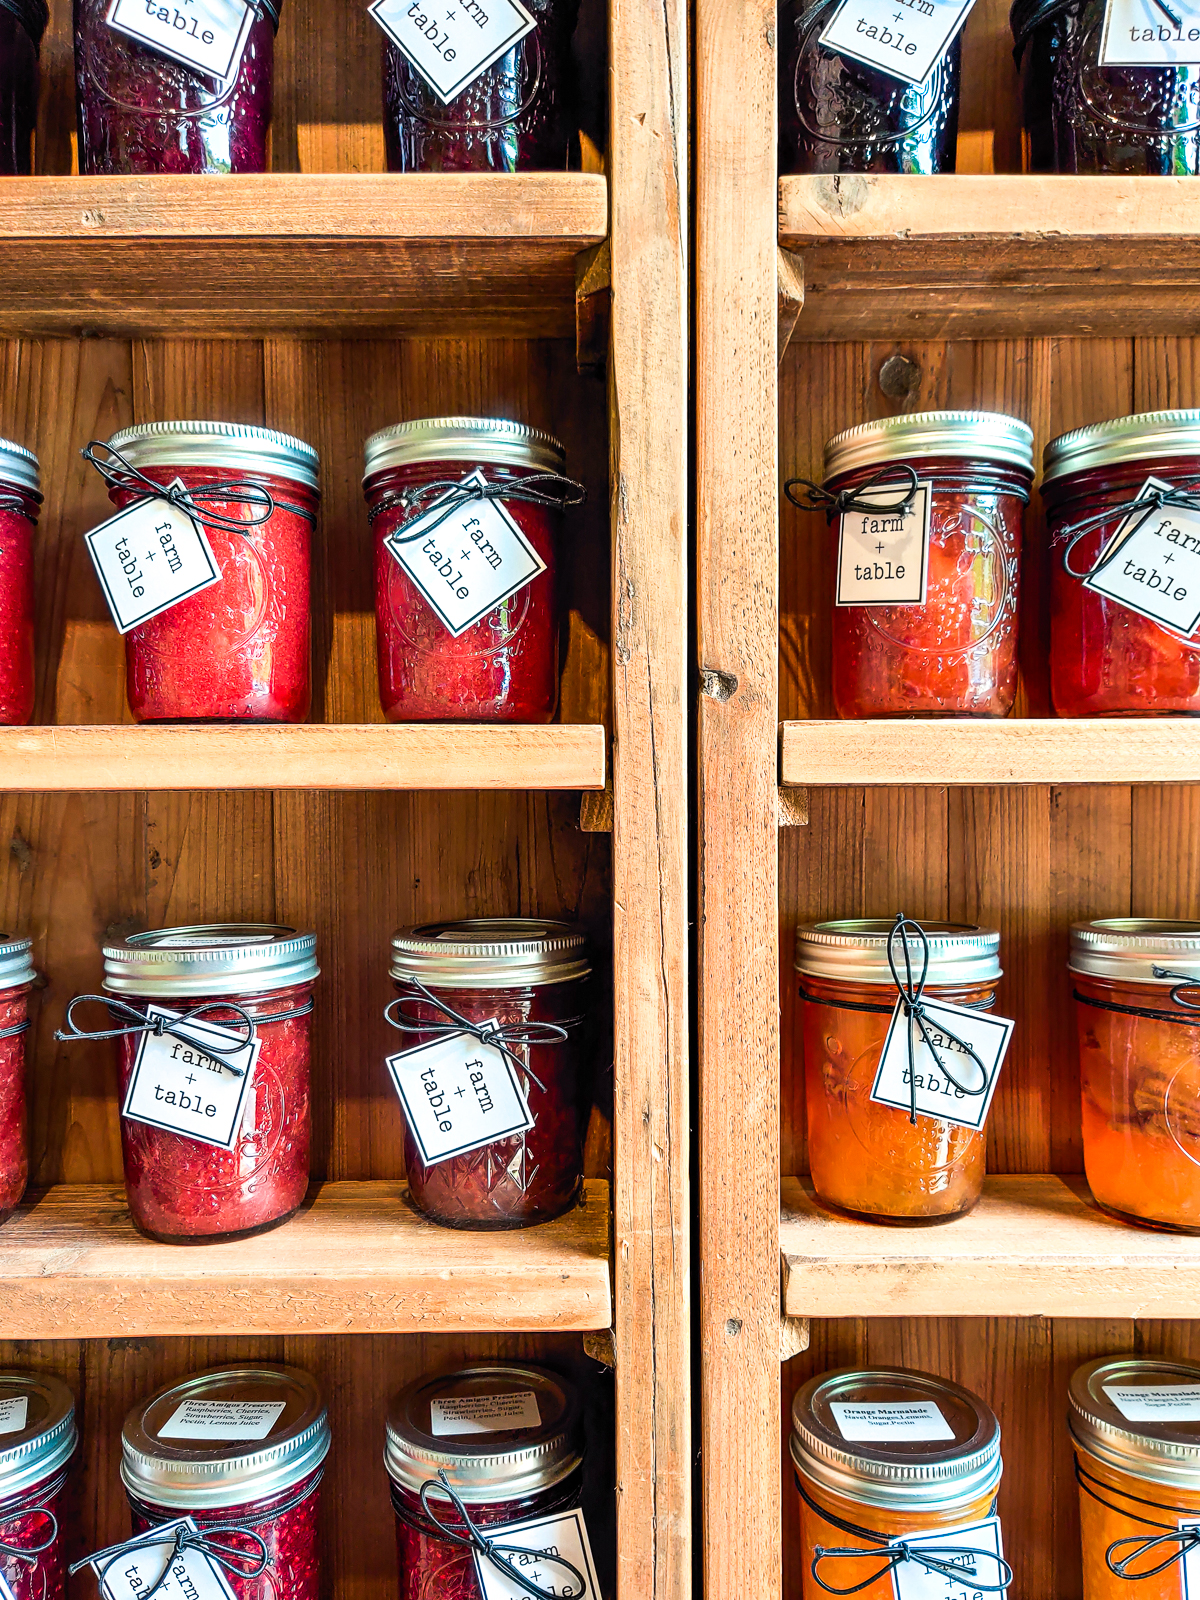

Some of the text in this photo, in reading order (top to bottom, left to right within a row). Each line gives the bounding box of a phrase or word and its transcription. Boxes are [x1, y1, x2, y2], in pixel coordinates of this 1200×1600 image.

[145, 0, 214, 44] table
[407, 2, 457, 62] table
[855, 18, 918, 55] table
[1129, 25, 1200, 42] table
[461, 517, 503, 570] farm
[861, 517, 904, 534] farm
[114, 537, 145, 598] table
[155, 521, 184, 574] farm
[422, 538, 470, 600] table
[854, 562, 906, 581] table
[1122, 559, 1187, 601] table
[169, 1043, 223, 1074] farm
[154, 1084, 217, 1117] table
[420, 1067, 452, 1133] table
[465, 1059, 494, 1114] farm
[185, 1406, 233, 1414] Raspberries,
